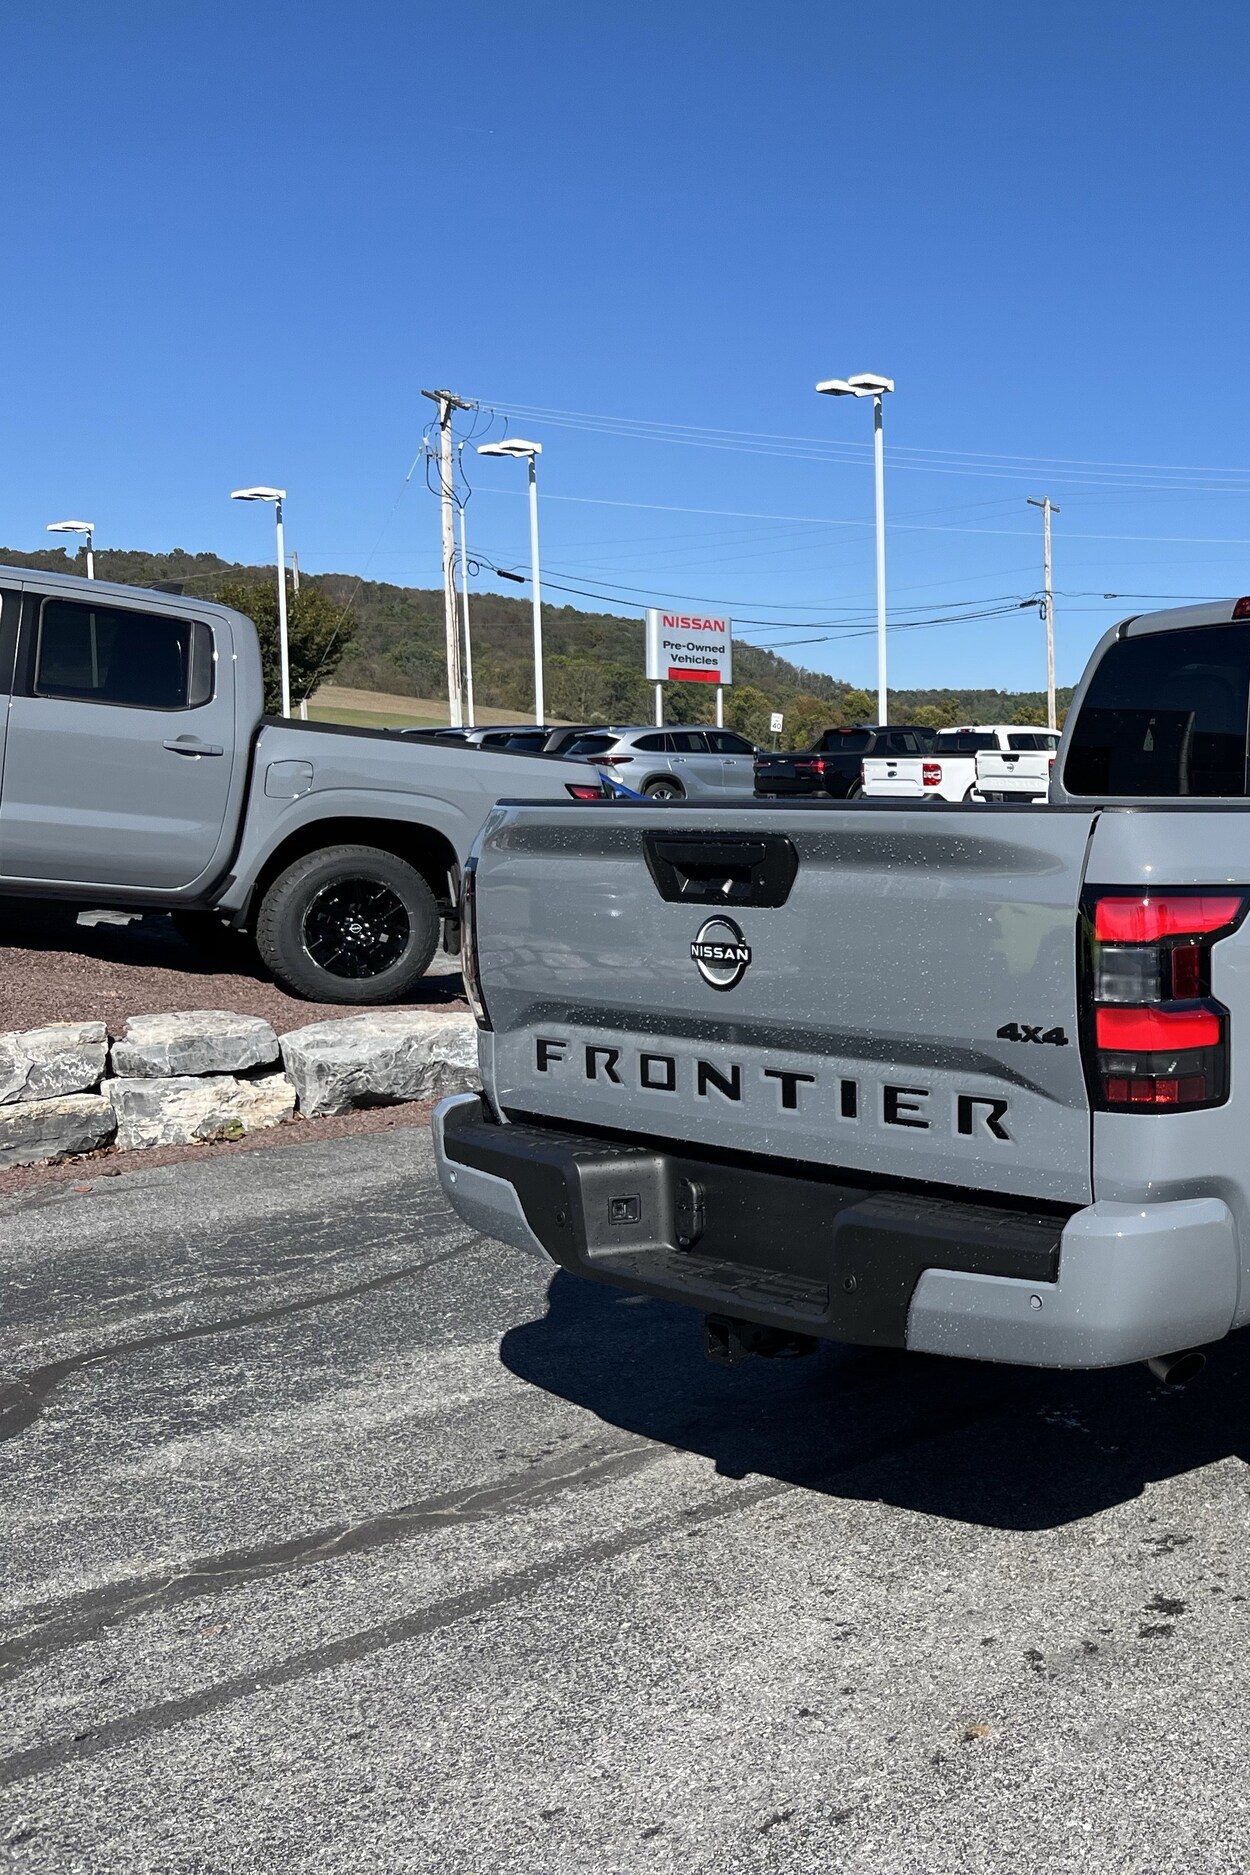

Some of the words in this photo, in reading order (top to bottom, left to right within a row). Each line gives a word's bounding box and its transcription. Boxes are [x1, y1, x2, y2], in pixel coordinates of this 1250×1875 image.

[662, 615, 725, 632] NISSAN
[663, 640, 725, 653] Pre-Owned
[671, 654, 718, 665] Vehicles
[691, 944, 749, 961] NISSAN
[536, 1038, 1010, 1140] FRONTIER
